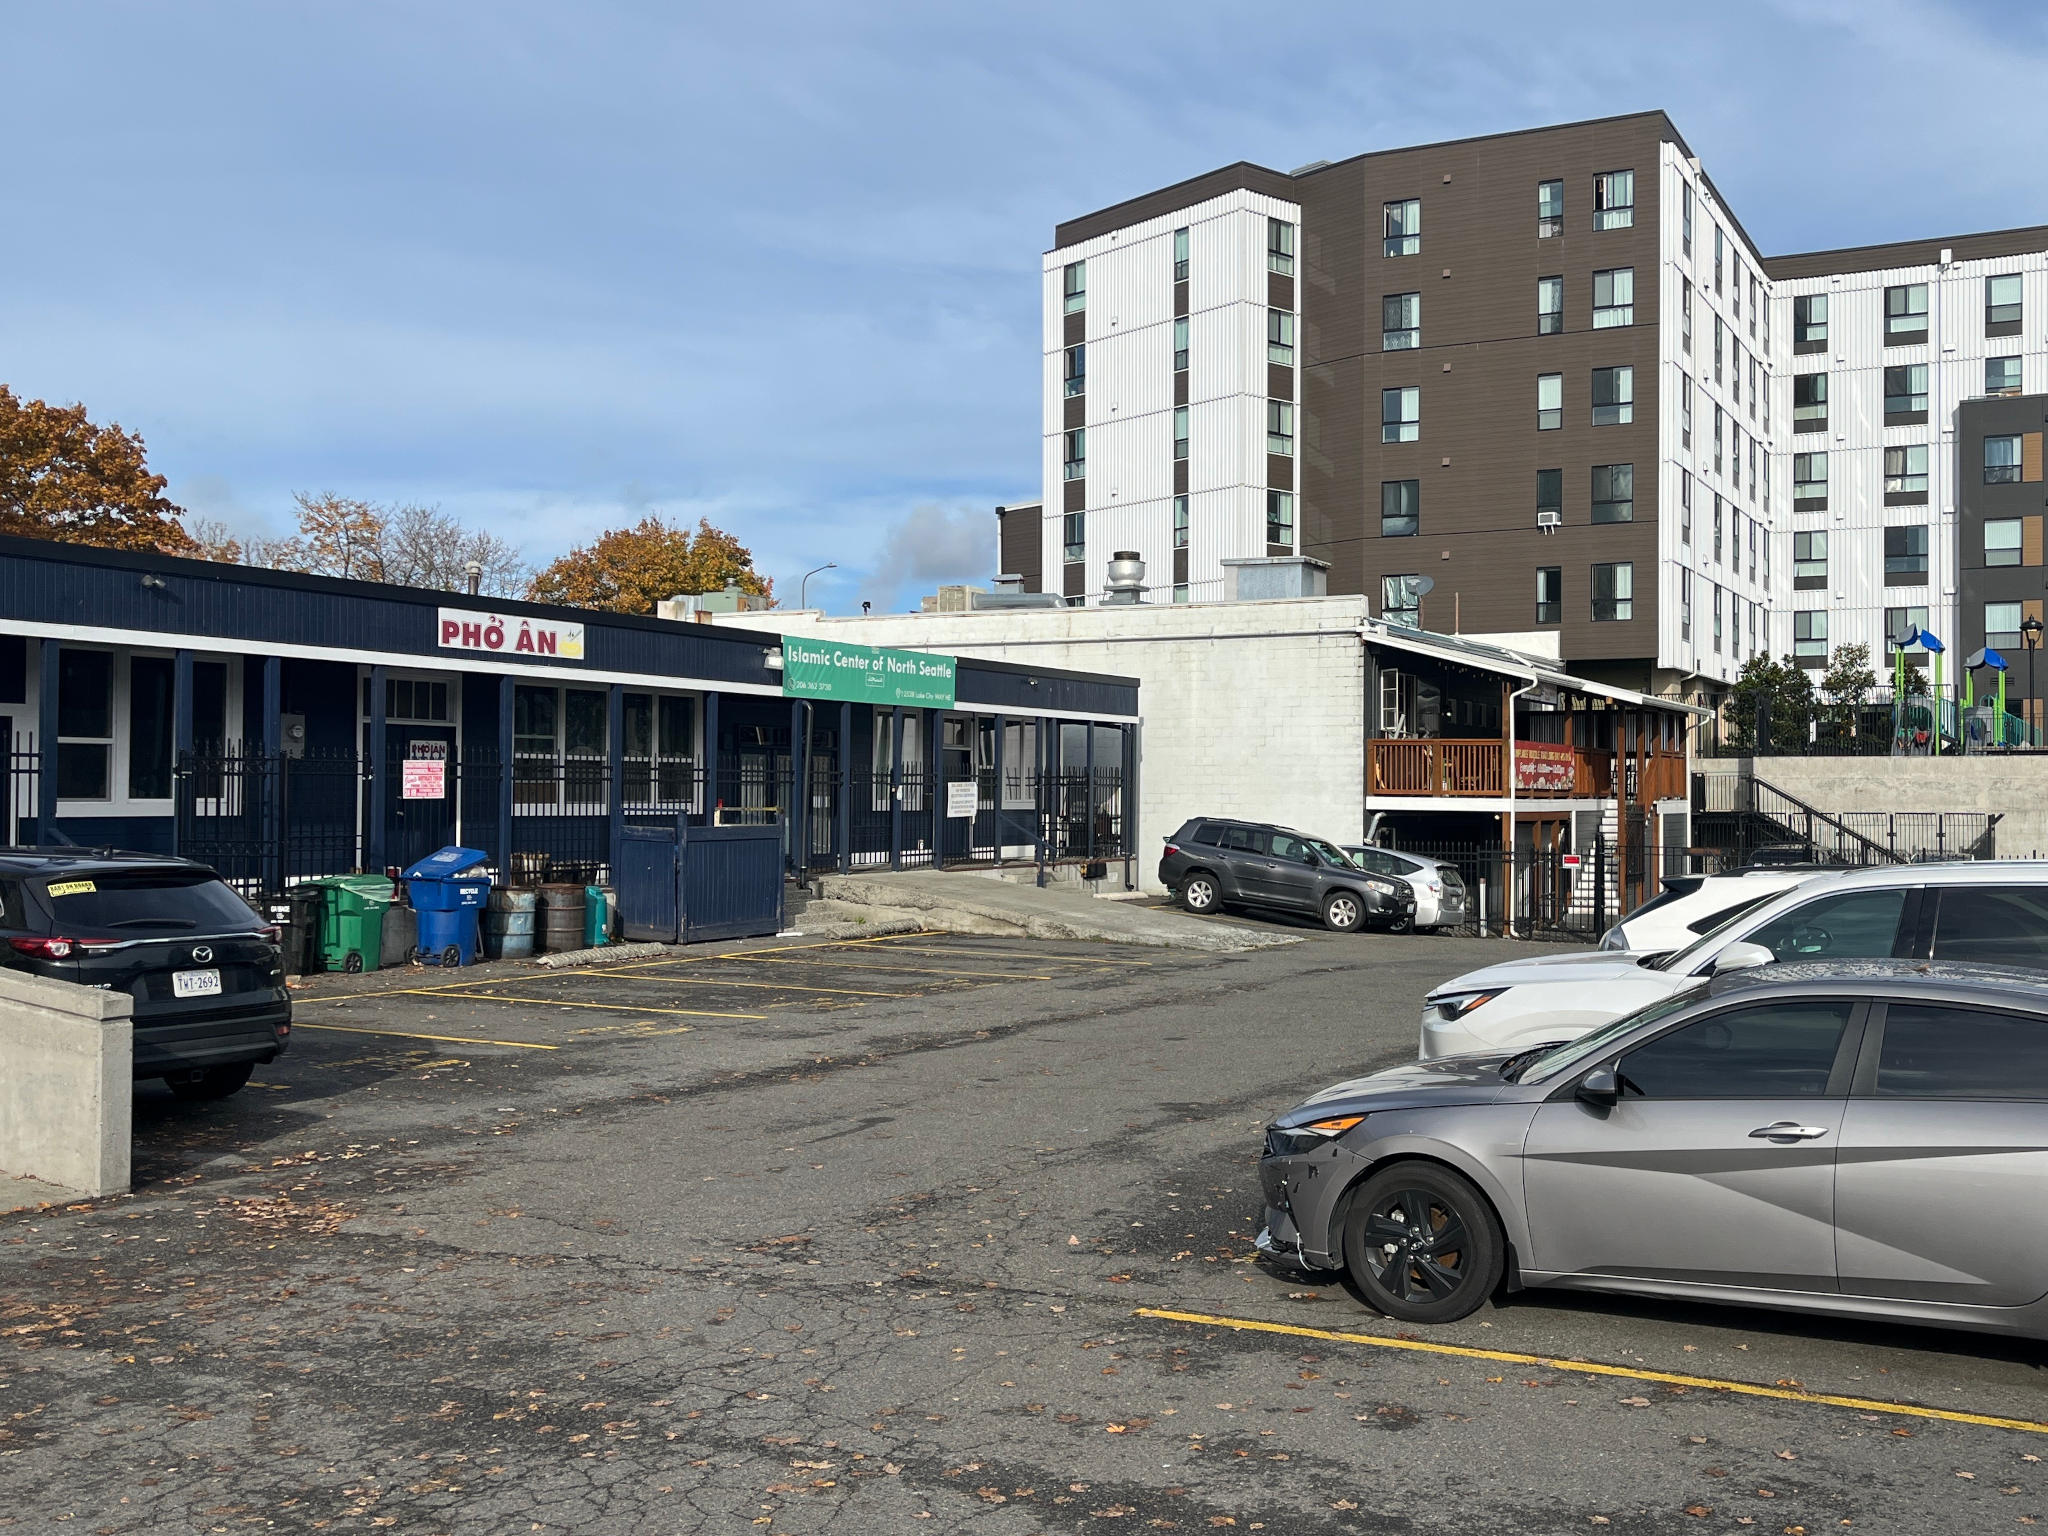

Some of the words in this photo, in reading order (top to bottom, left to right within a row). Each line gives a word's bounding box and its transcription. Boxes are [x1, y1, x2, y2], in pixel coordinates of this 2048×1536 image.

[442, 615, 504, 650] PHỞ
[515, 619, 557, 655] ÂN
[787, 645, 831, 666] Islamic
[833, 650, 869, 670] Center
[872, 656, 884, 671] of
[887, 656, 916, 675] North
[919, 660, 952, 678] Seattle
